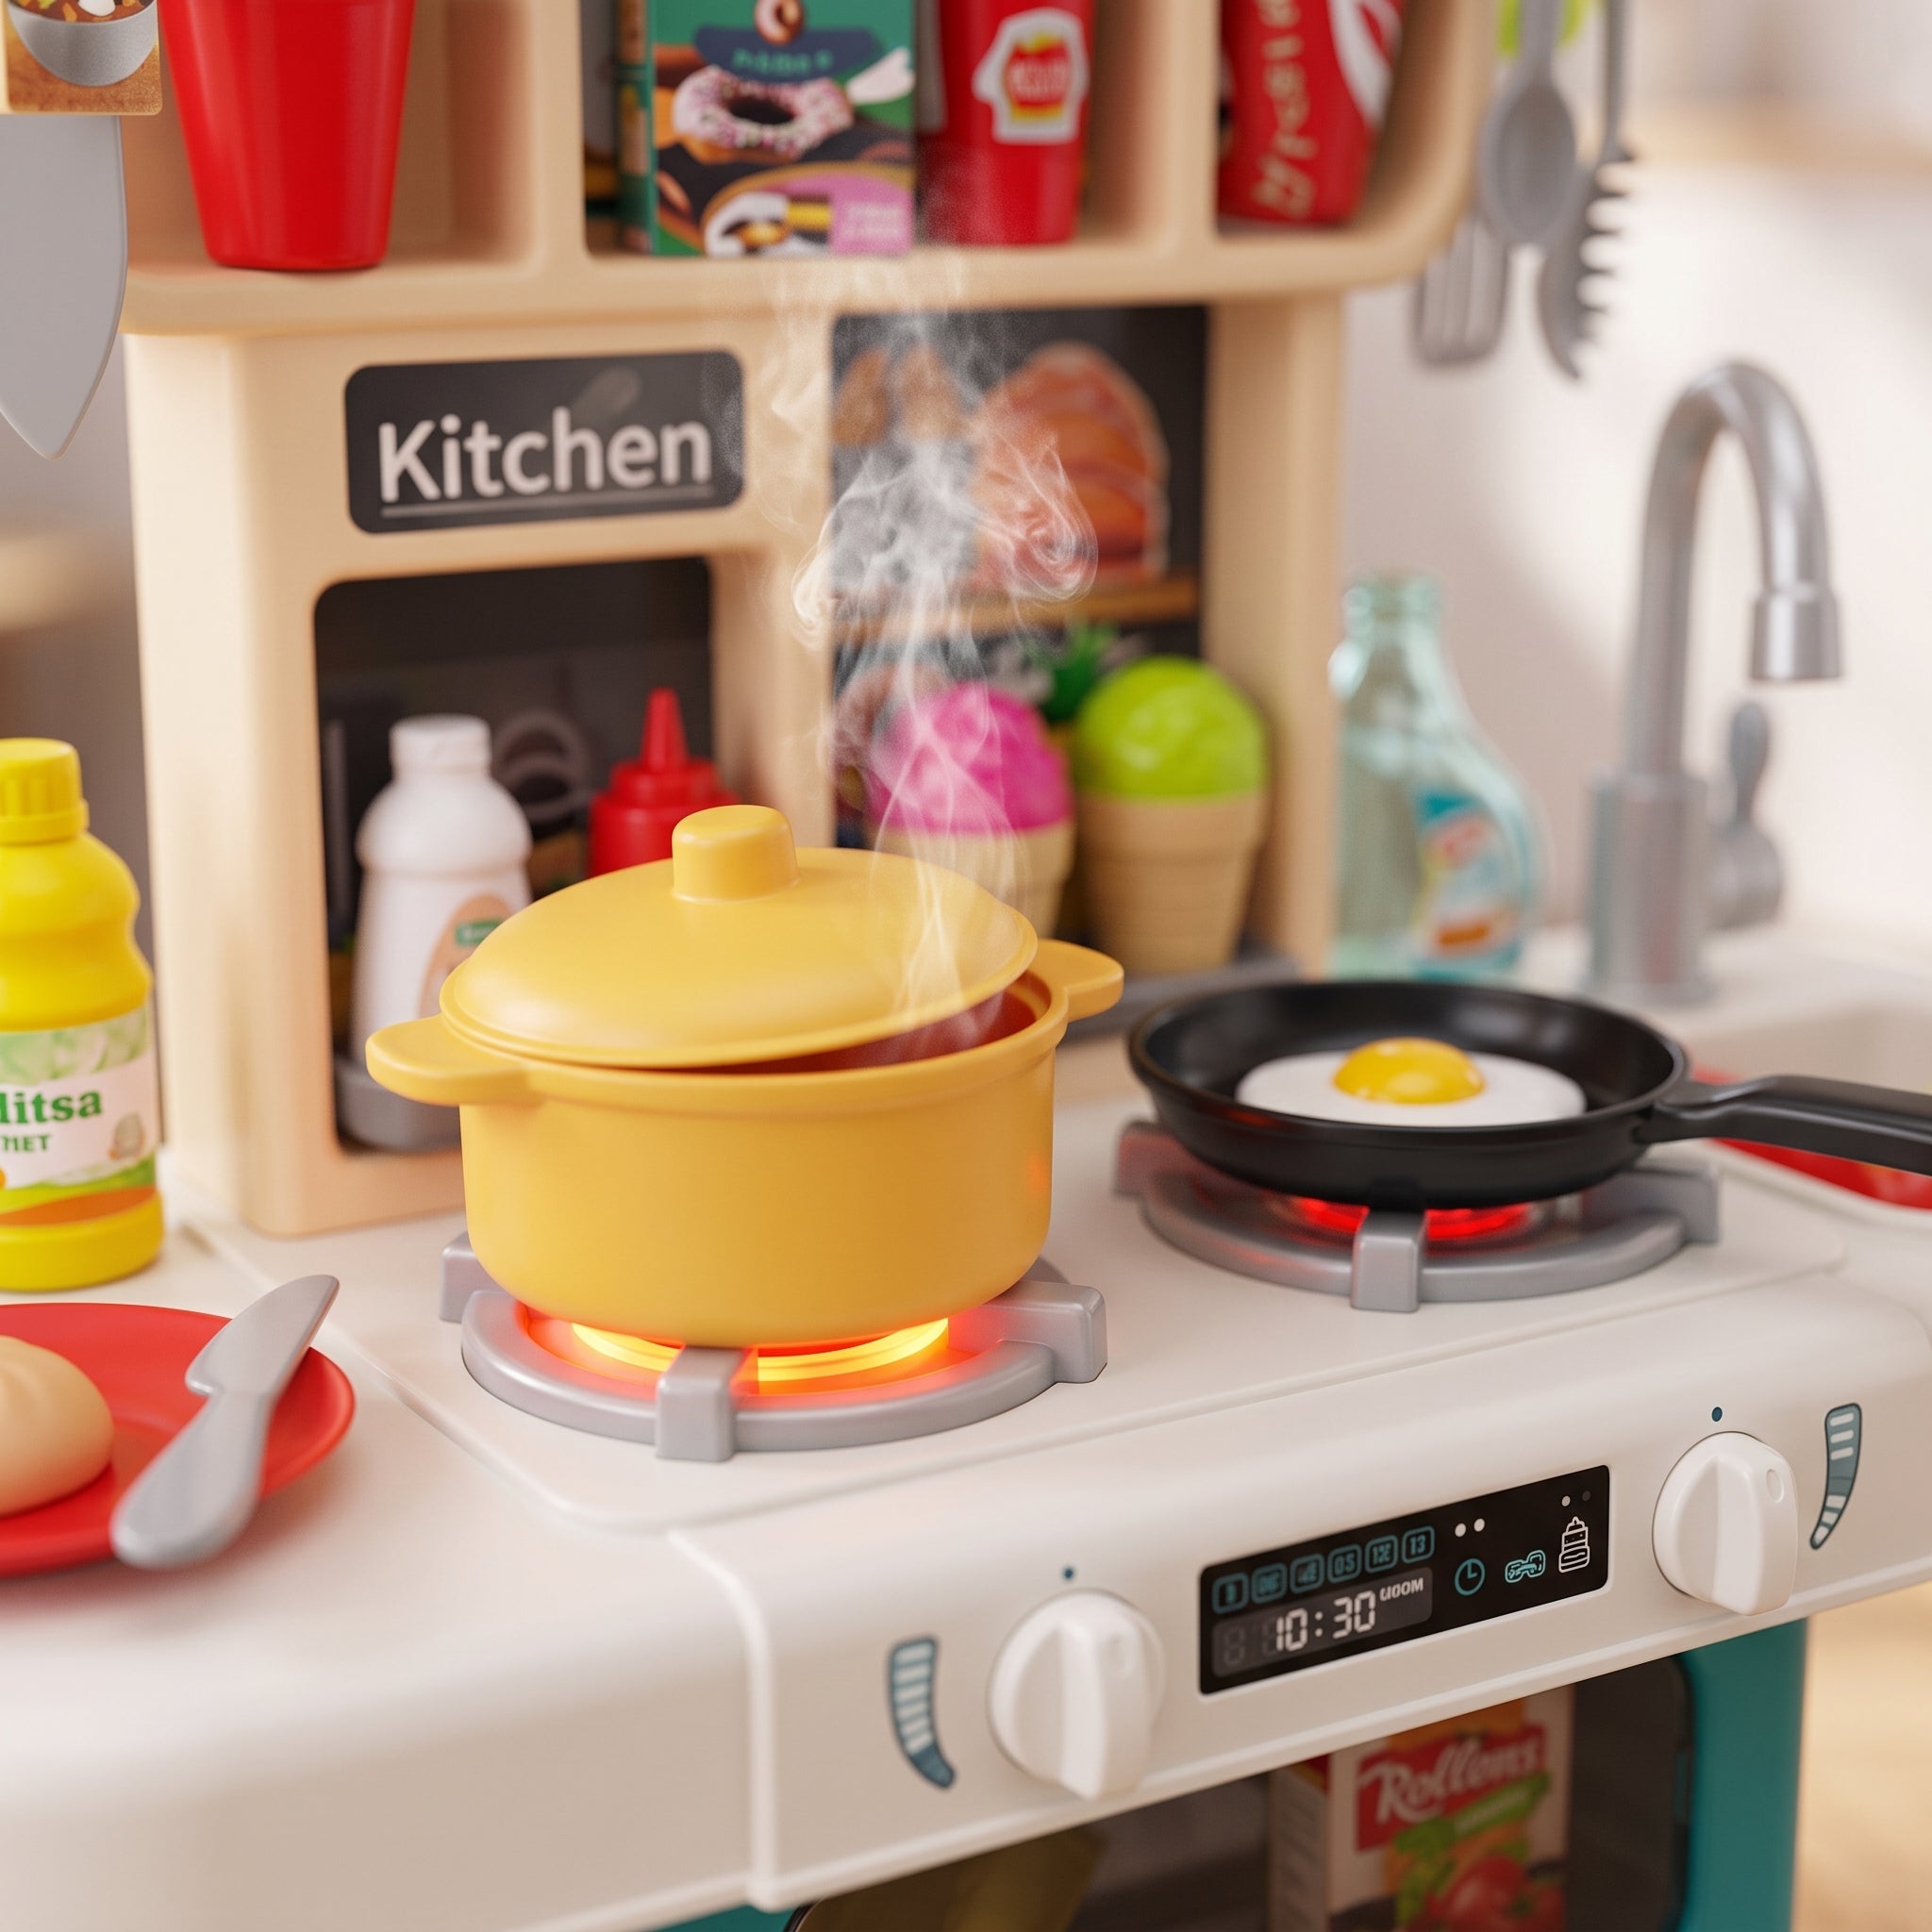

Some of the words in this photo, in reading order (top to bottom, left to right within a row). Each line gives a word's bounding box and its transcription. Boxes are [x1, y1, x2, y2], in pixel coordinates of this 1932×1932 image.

[378, 406, 712, 503] Kitchen
[1409, 1534, 1426, 1556] 13
[1275, 1591, 1375, 1652] 10:30
